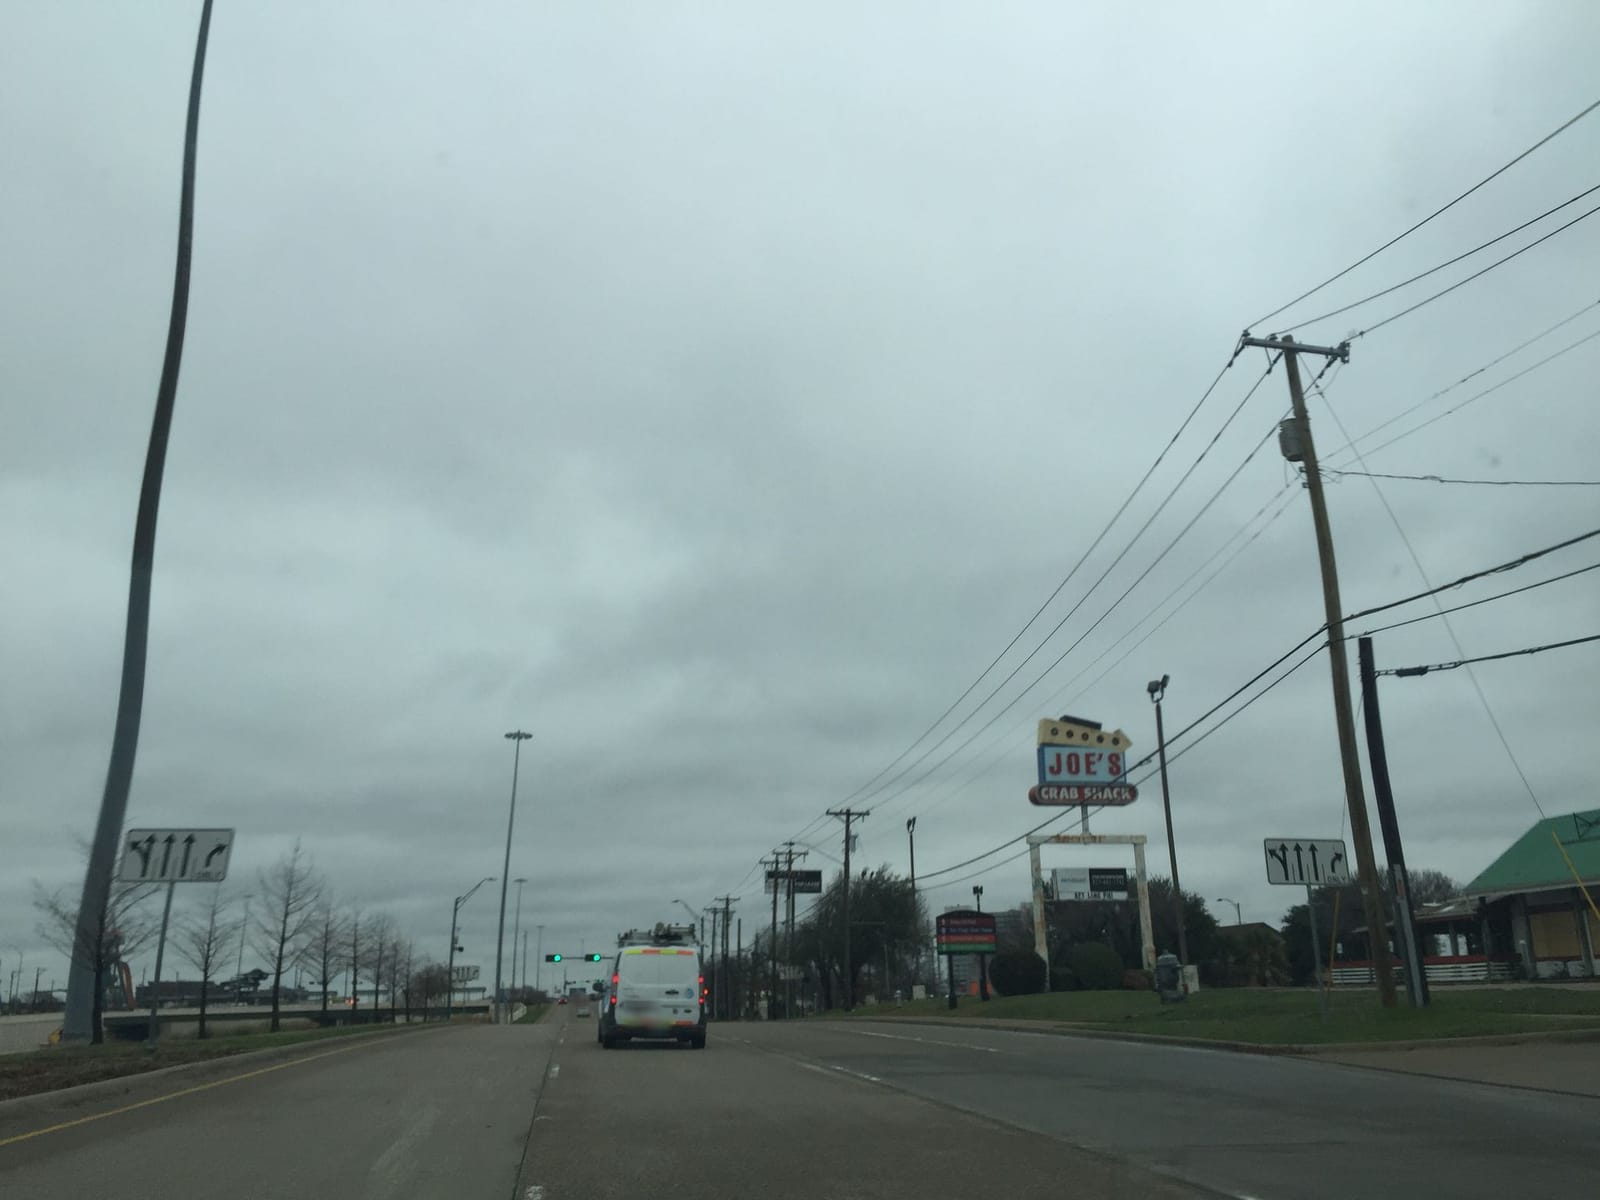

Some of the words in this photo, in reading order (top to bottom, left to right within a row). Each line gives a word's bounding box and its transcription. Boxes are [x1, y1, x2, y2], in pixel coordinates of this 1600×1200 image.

[1048, 752, 1122, 776] JOE'S
[1040, 786, 1079, 801] CRAB
[1083, 786, 1131, 801] SHACK
